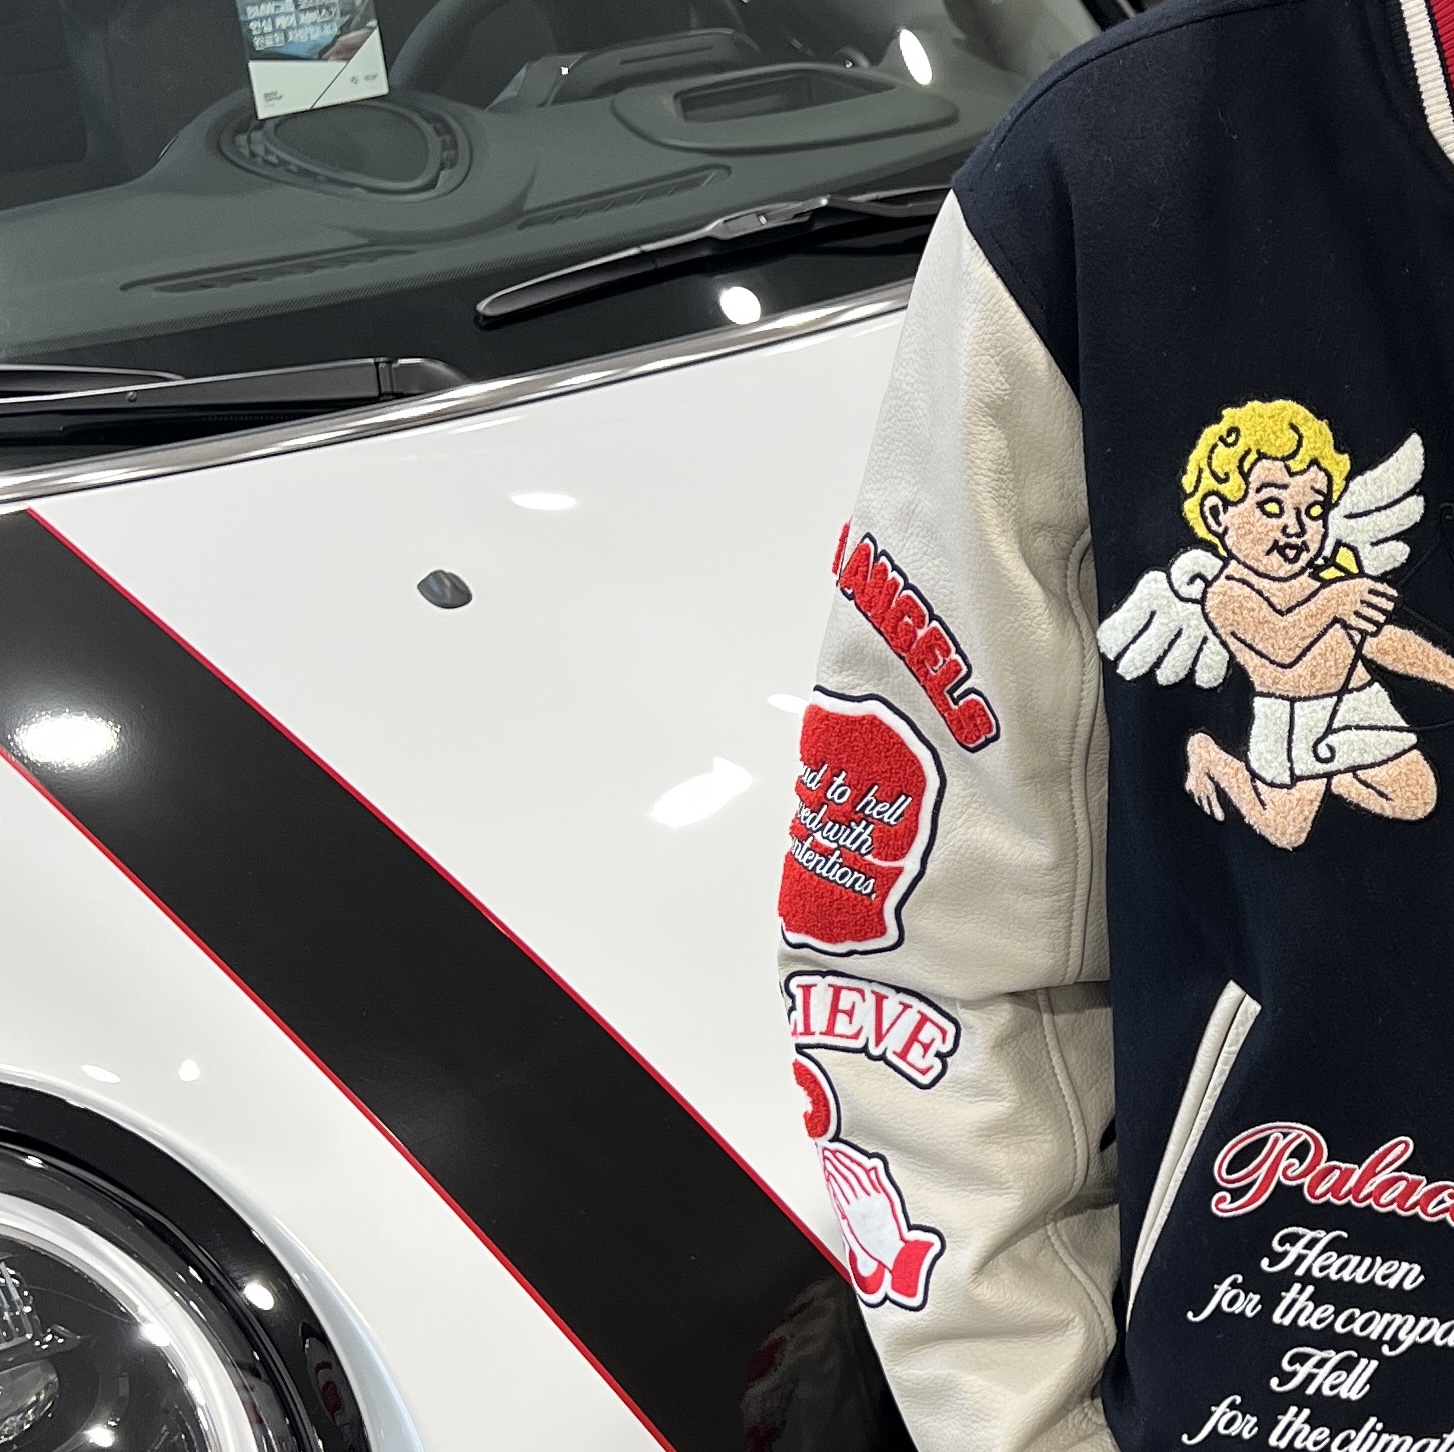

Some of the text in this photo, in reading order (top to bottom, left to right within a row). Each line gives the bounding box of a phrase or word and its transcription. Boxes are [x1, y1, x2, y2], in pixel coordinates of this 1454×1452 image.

[826, 770, 851, 804] to
[856, 784, 913, 825] hell
[821, 819, 875, 855] with
[790, 982, 949, 1077] IEVE
[1260, 1226, 1425, 1290] Heaven
[1187, 1273, 1262, 1322] for
[1272, 1283, 1335, 1331] the
[1269, 1346, 1379, 1401] Hell
[1182, 1395, 1259, 1446] for
[1268, 1405, 1331, 1452] the
